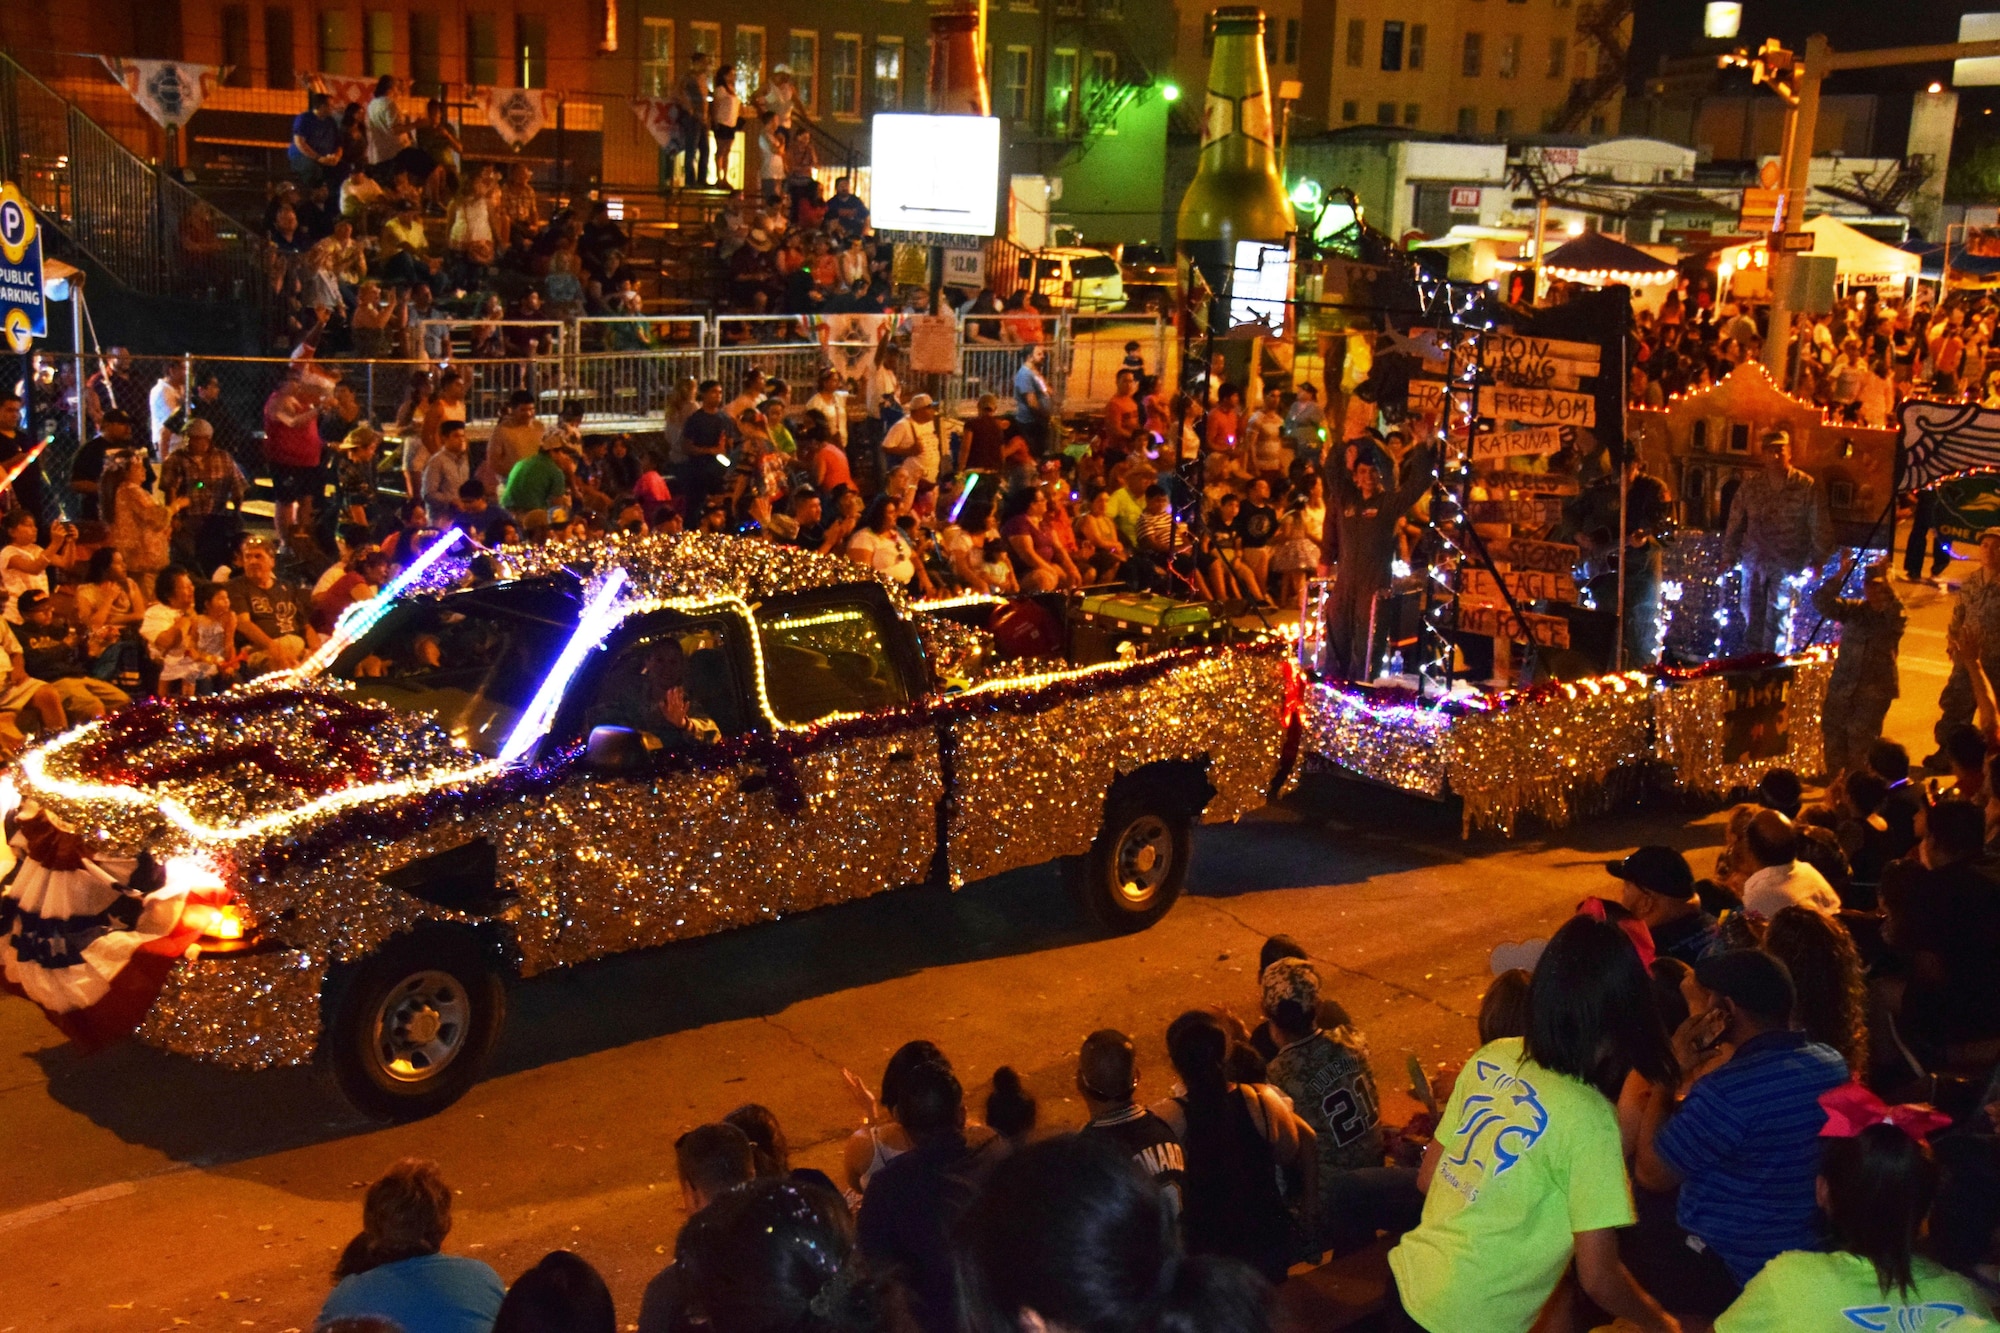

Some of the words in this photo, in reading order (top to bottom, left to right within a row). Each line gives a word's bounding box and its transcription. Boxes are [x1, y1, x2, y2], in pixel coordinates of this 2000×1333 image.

[5, 207, 20, 238] P
[881, 229, 923, 244] PUBLIC
[926, 234, 977, 248] PARKING
[0, 287, 40, 306] ARKING
[1493, 392, 1588, 423] FREEDOM
[1478, 431, 1551, 455] KATRINA
[1940, 525, 1970, 540] ONE
[1502, 572, 1568, 602] EAGLE
[1321, 1073, 1381, 1148] 21
